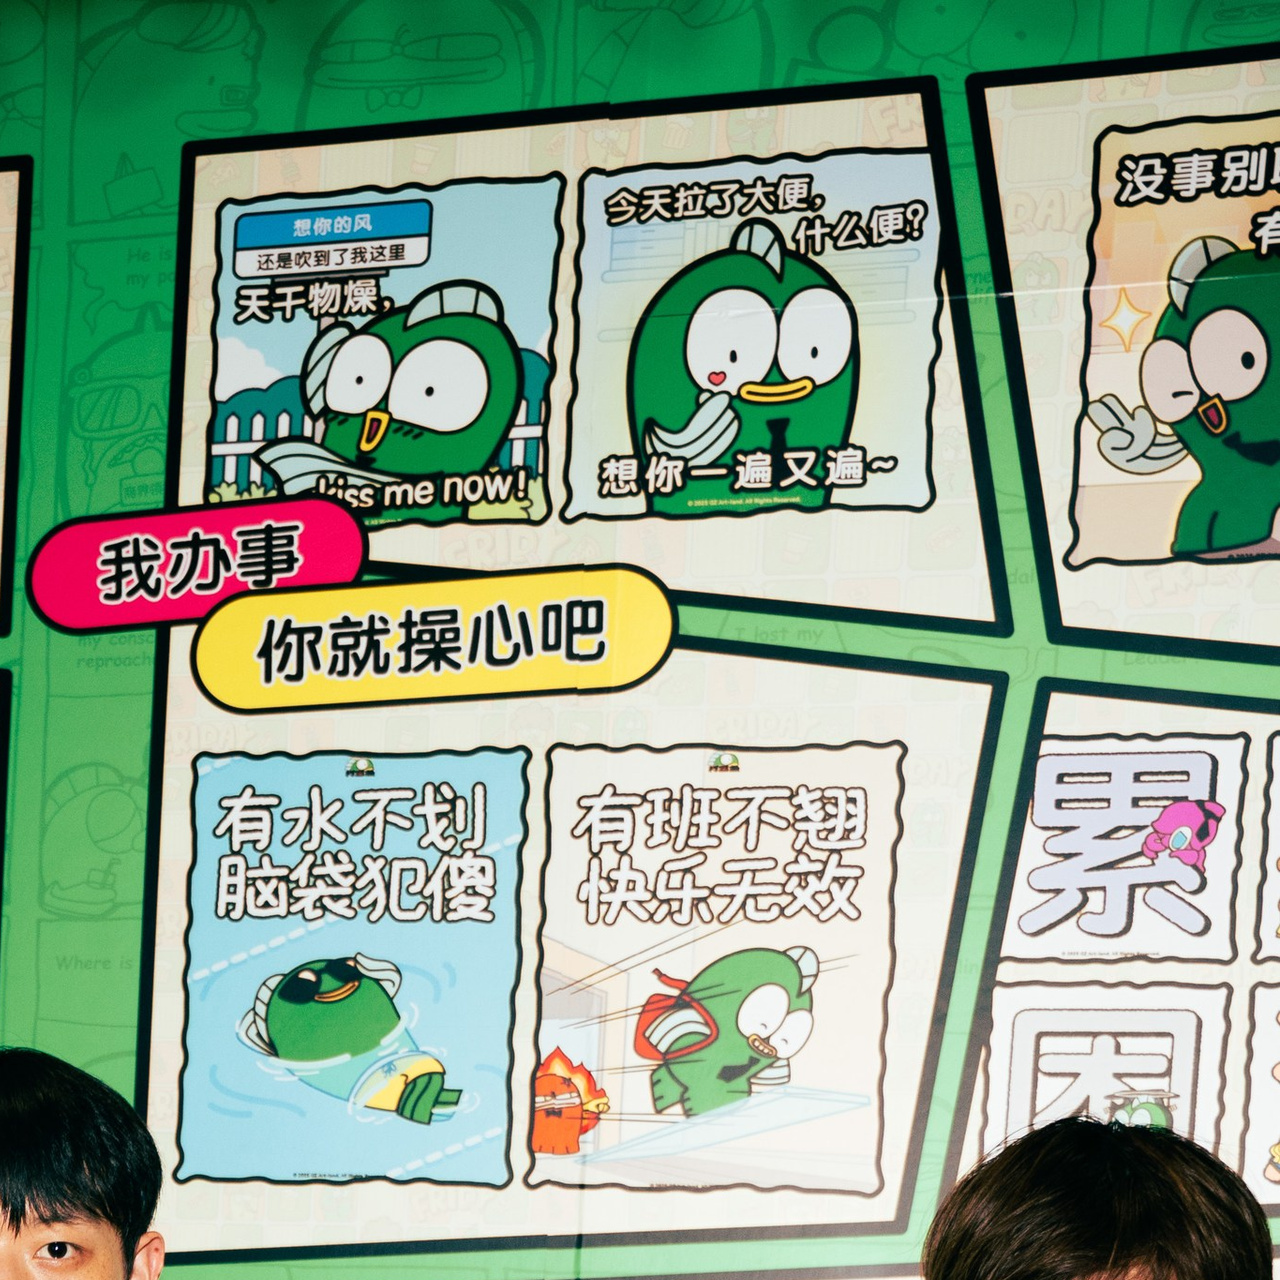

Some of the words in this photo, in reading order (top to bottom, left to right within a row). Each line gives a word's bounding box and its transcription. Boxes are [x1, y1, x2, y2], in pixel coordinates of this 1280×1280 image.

[607, 178, 825, 222] 今天拉了大便，
[1120, 148, 1280, 203] 没事别
[257, 244, 407, 272] 还是吹到了我这里
[293, 213, 373, 238] 想你的风
[384, 484, 435, 507] me
[443, 470, 527, 501] now!
[99, 521, 303, 603] 我办事
[256, 600, 607, 685] 你就操心吧
[213, 783, 489, 853] 有水不划
[577, 783, 868, 852] 有班不翘
[1018, 751, 1219, 937] 累
[216, 855, 497, 922] 脑袋犯傻
[578, 854, 865, 925] 快乐无效
